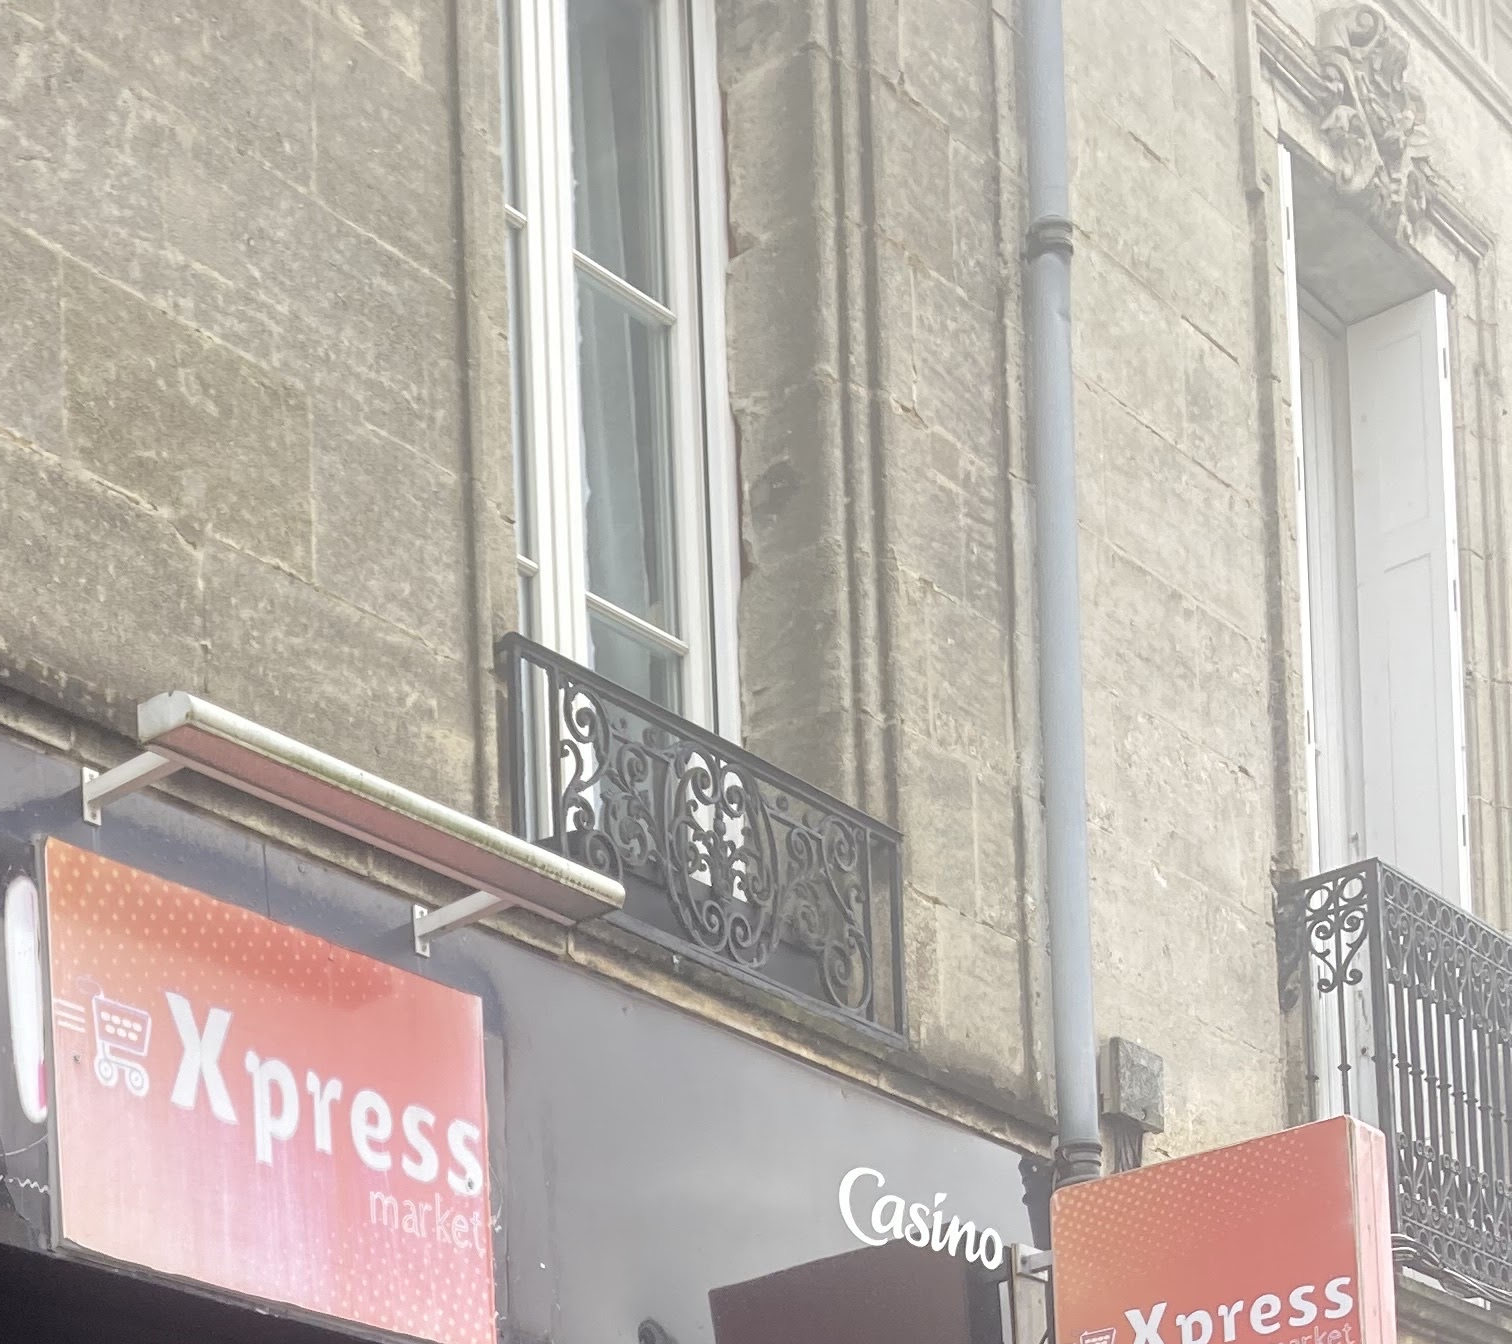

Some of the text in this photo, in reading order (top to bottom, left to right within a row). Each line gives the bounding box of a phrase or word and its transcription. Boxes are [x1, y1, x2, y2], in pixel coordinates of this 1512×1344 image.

[165, 991, 484, 1197] Xpress
[369, 1190, 486, 1259] market
[838, 1166, 1004, 1270] Casino
